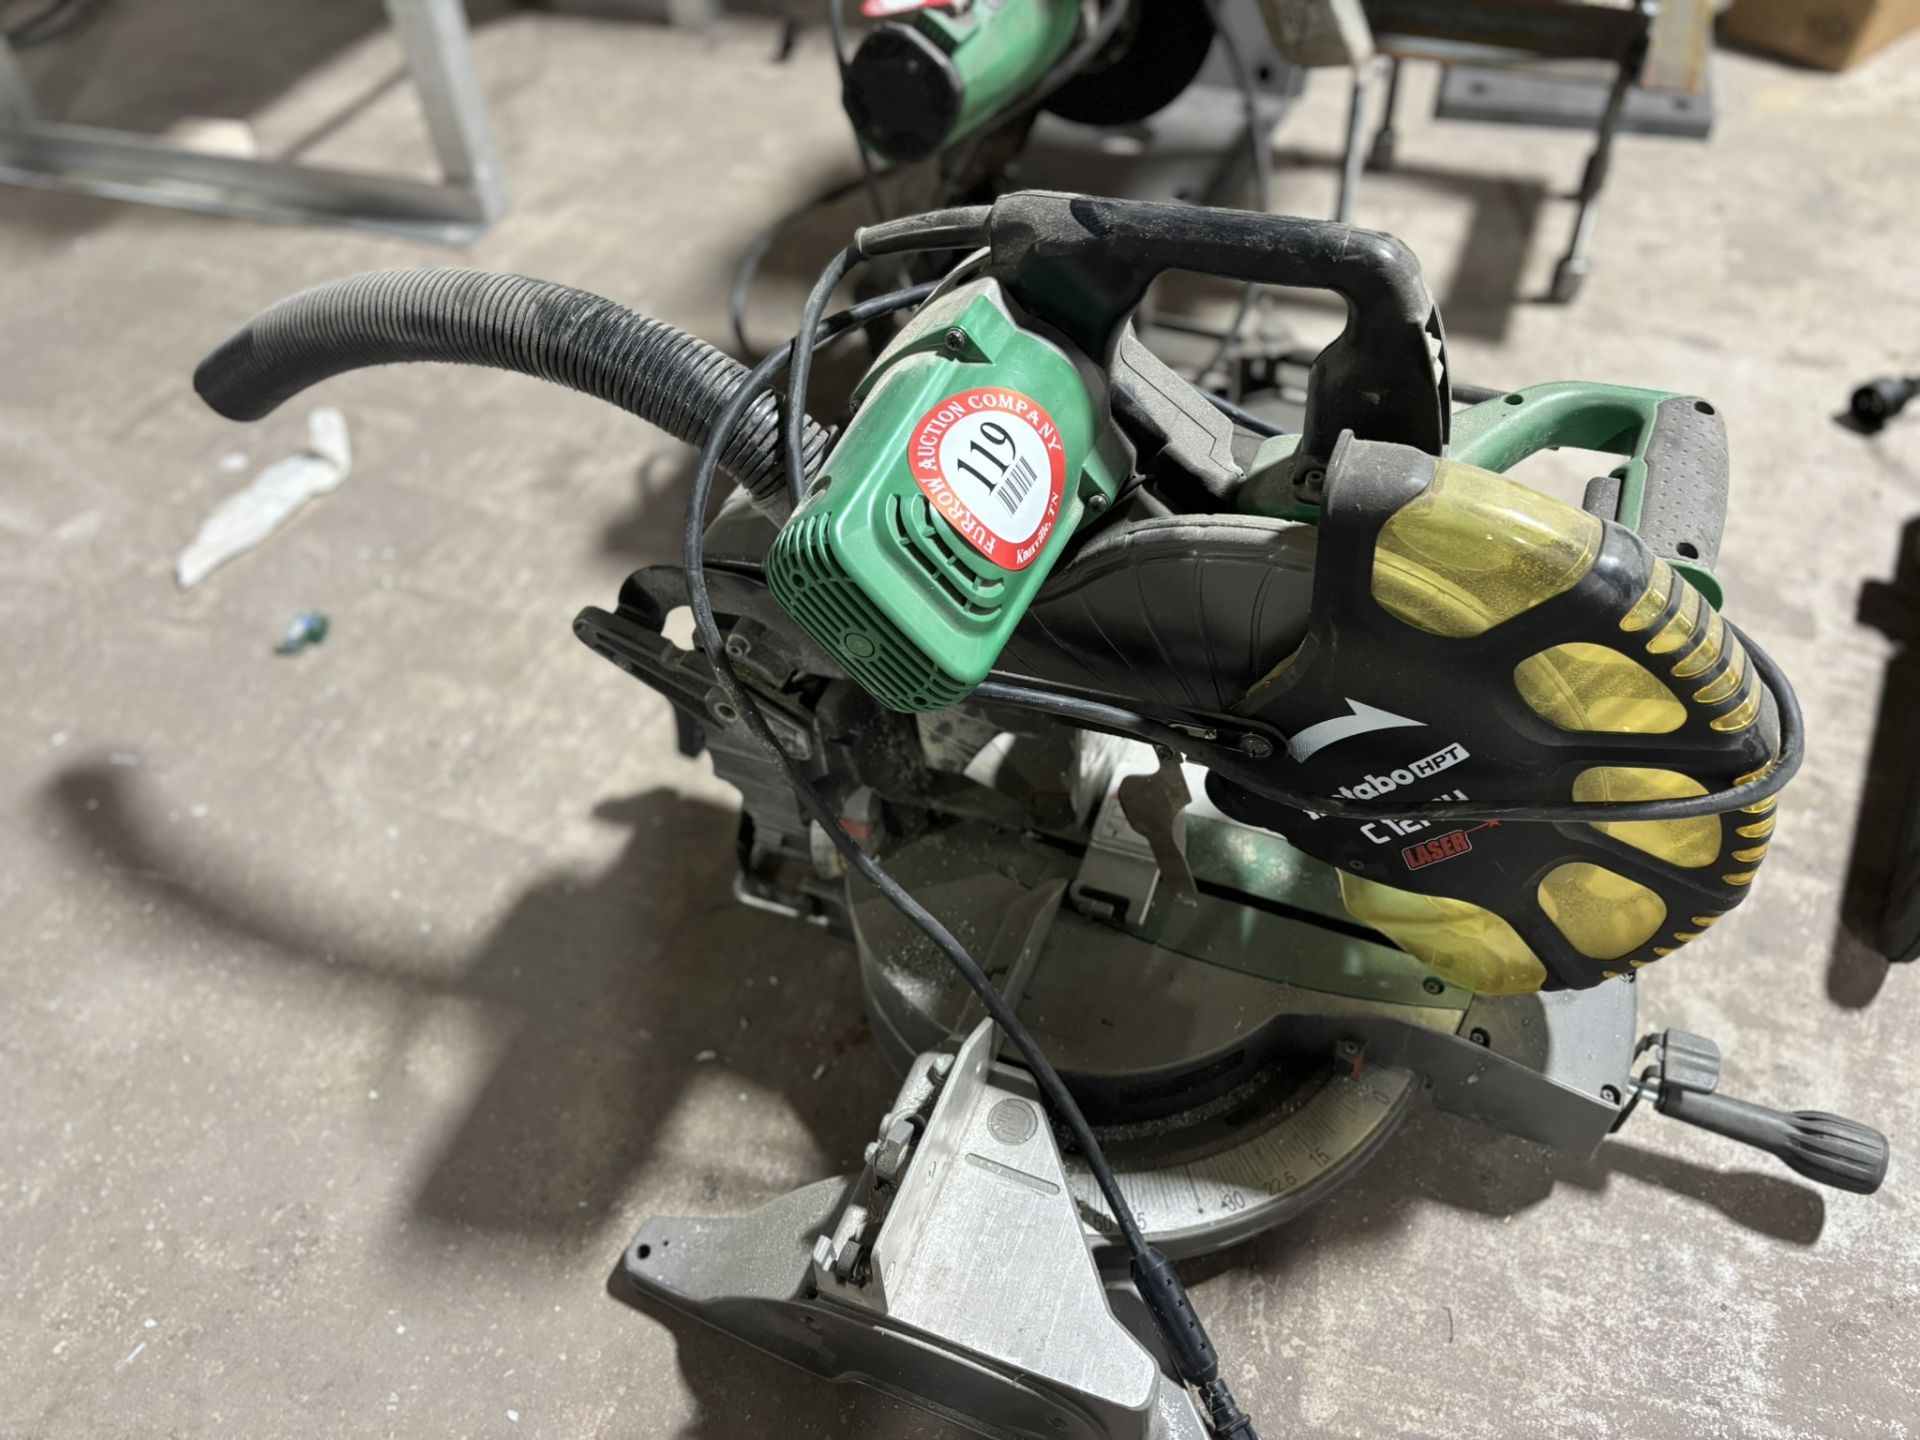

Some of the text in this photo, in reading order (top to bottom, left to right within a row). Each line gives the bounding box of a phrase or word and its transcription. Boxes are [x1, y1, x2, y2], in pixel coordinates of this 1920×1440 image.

[957, 421, 1016, 496] 119
[917, 393, 1063, 555] FURROW AUCTION COMPANY
[1415, 746, 1461, 776] HPT
[1403, 832, 1470, 868] LASER
[1308, 1147, 1330, 1168] 15
[1263, 1170, 1297, 1196] 22.5
[1223, 1190, 1246, 1213] 30
[1093, 1213, 1113, 1233] 50
